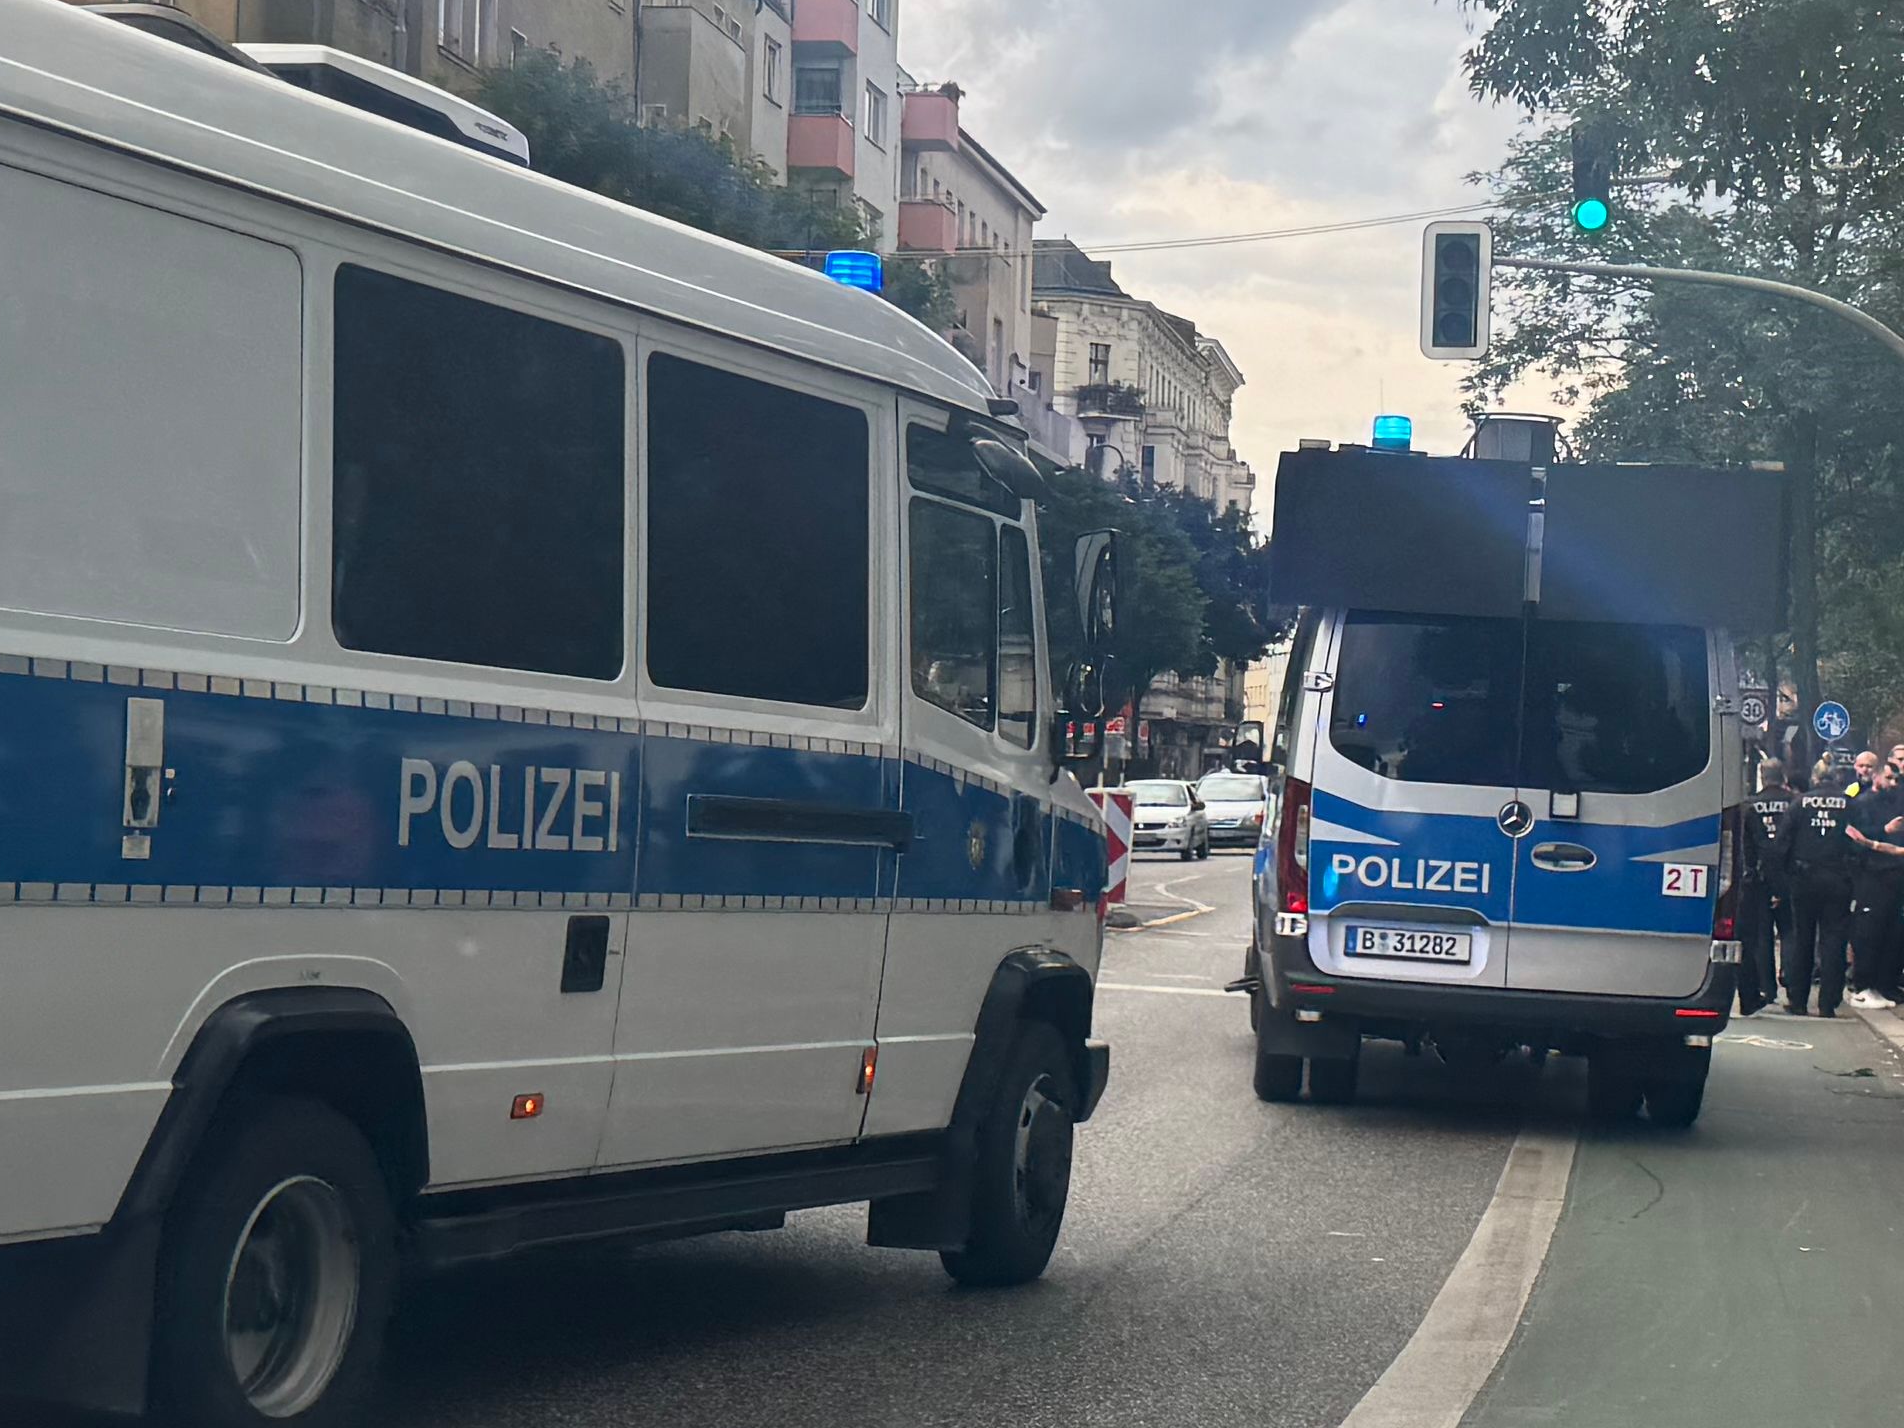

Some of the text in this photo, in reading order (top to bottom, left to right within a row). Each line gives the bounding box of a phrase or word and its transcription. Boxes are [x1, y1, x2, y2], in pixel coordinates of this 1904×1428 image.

[397, 756, 620, 852] POLIZEI
[1802, 796, 1846, 809] POLIZEI
[1332, 853, 1491, 894] POLIZEI
[1362, 930, 1457, 956] B 31282
